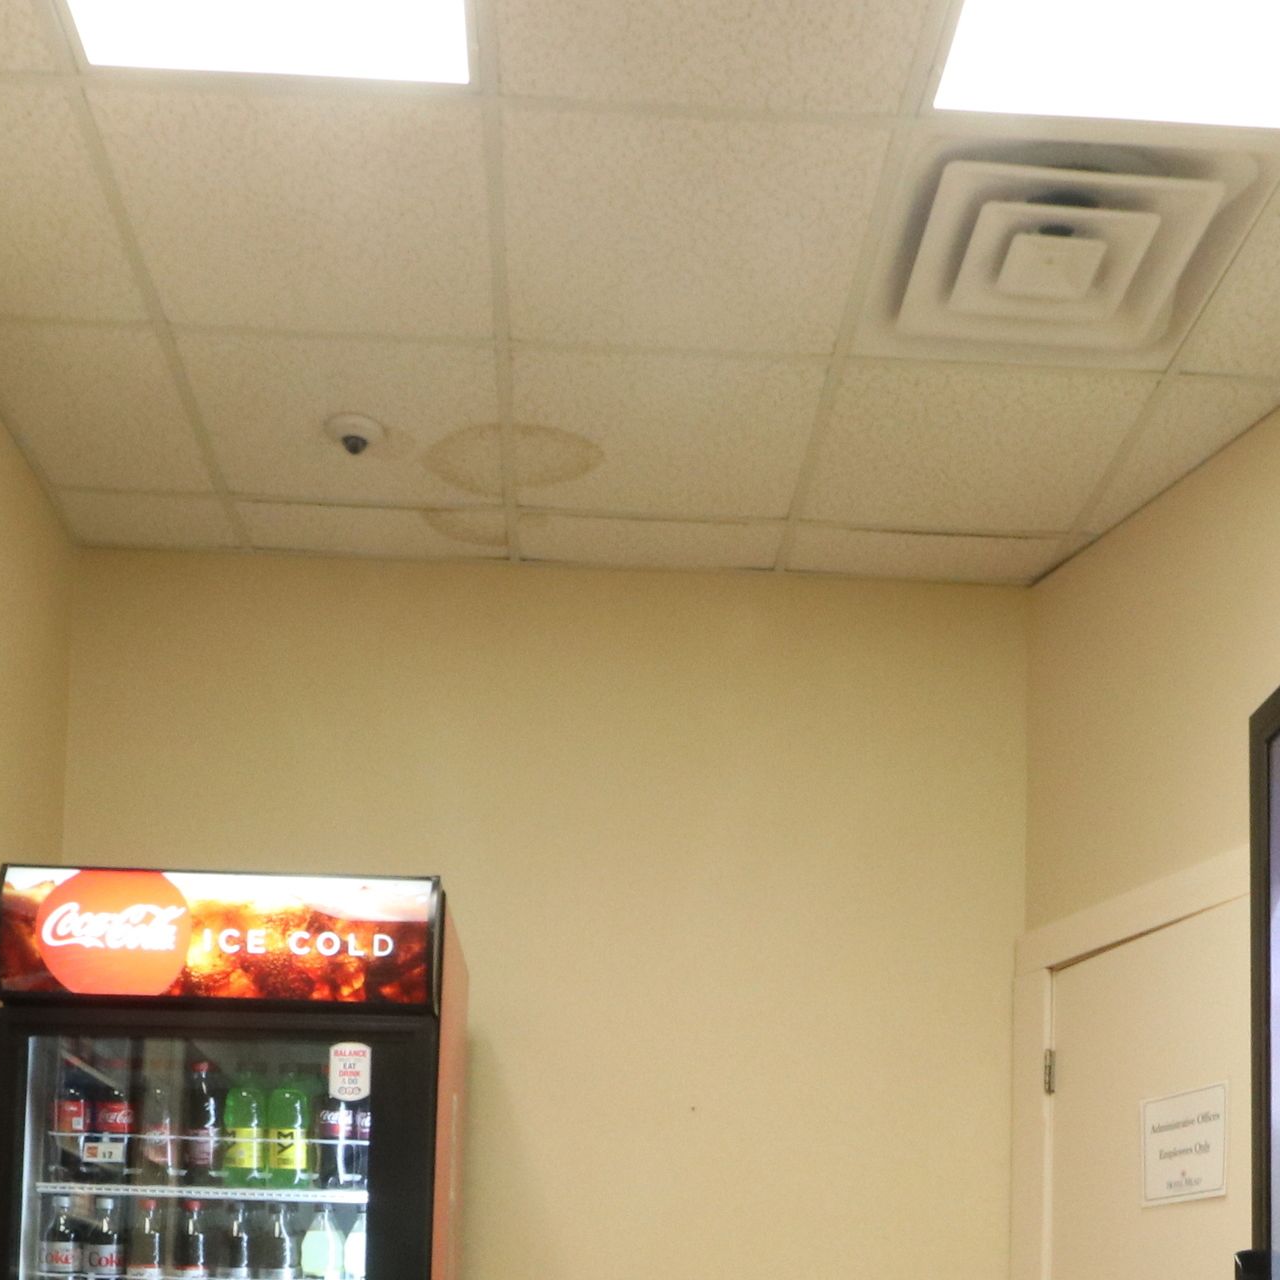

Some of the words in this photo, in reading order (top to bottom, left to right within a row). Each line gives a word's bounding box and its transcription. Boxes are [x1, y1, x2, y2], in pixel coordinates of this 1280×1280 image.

[41, 901, 187, 951] Coca-Cola
[203, 927, 267, 955] ICE
[288, 929, 395, 958] COLD
